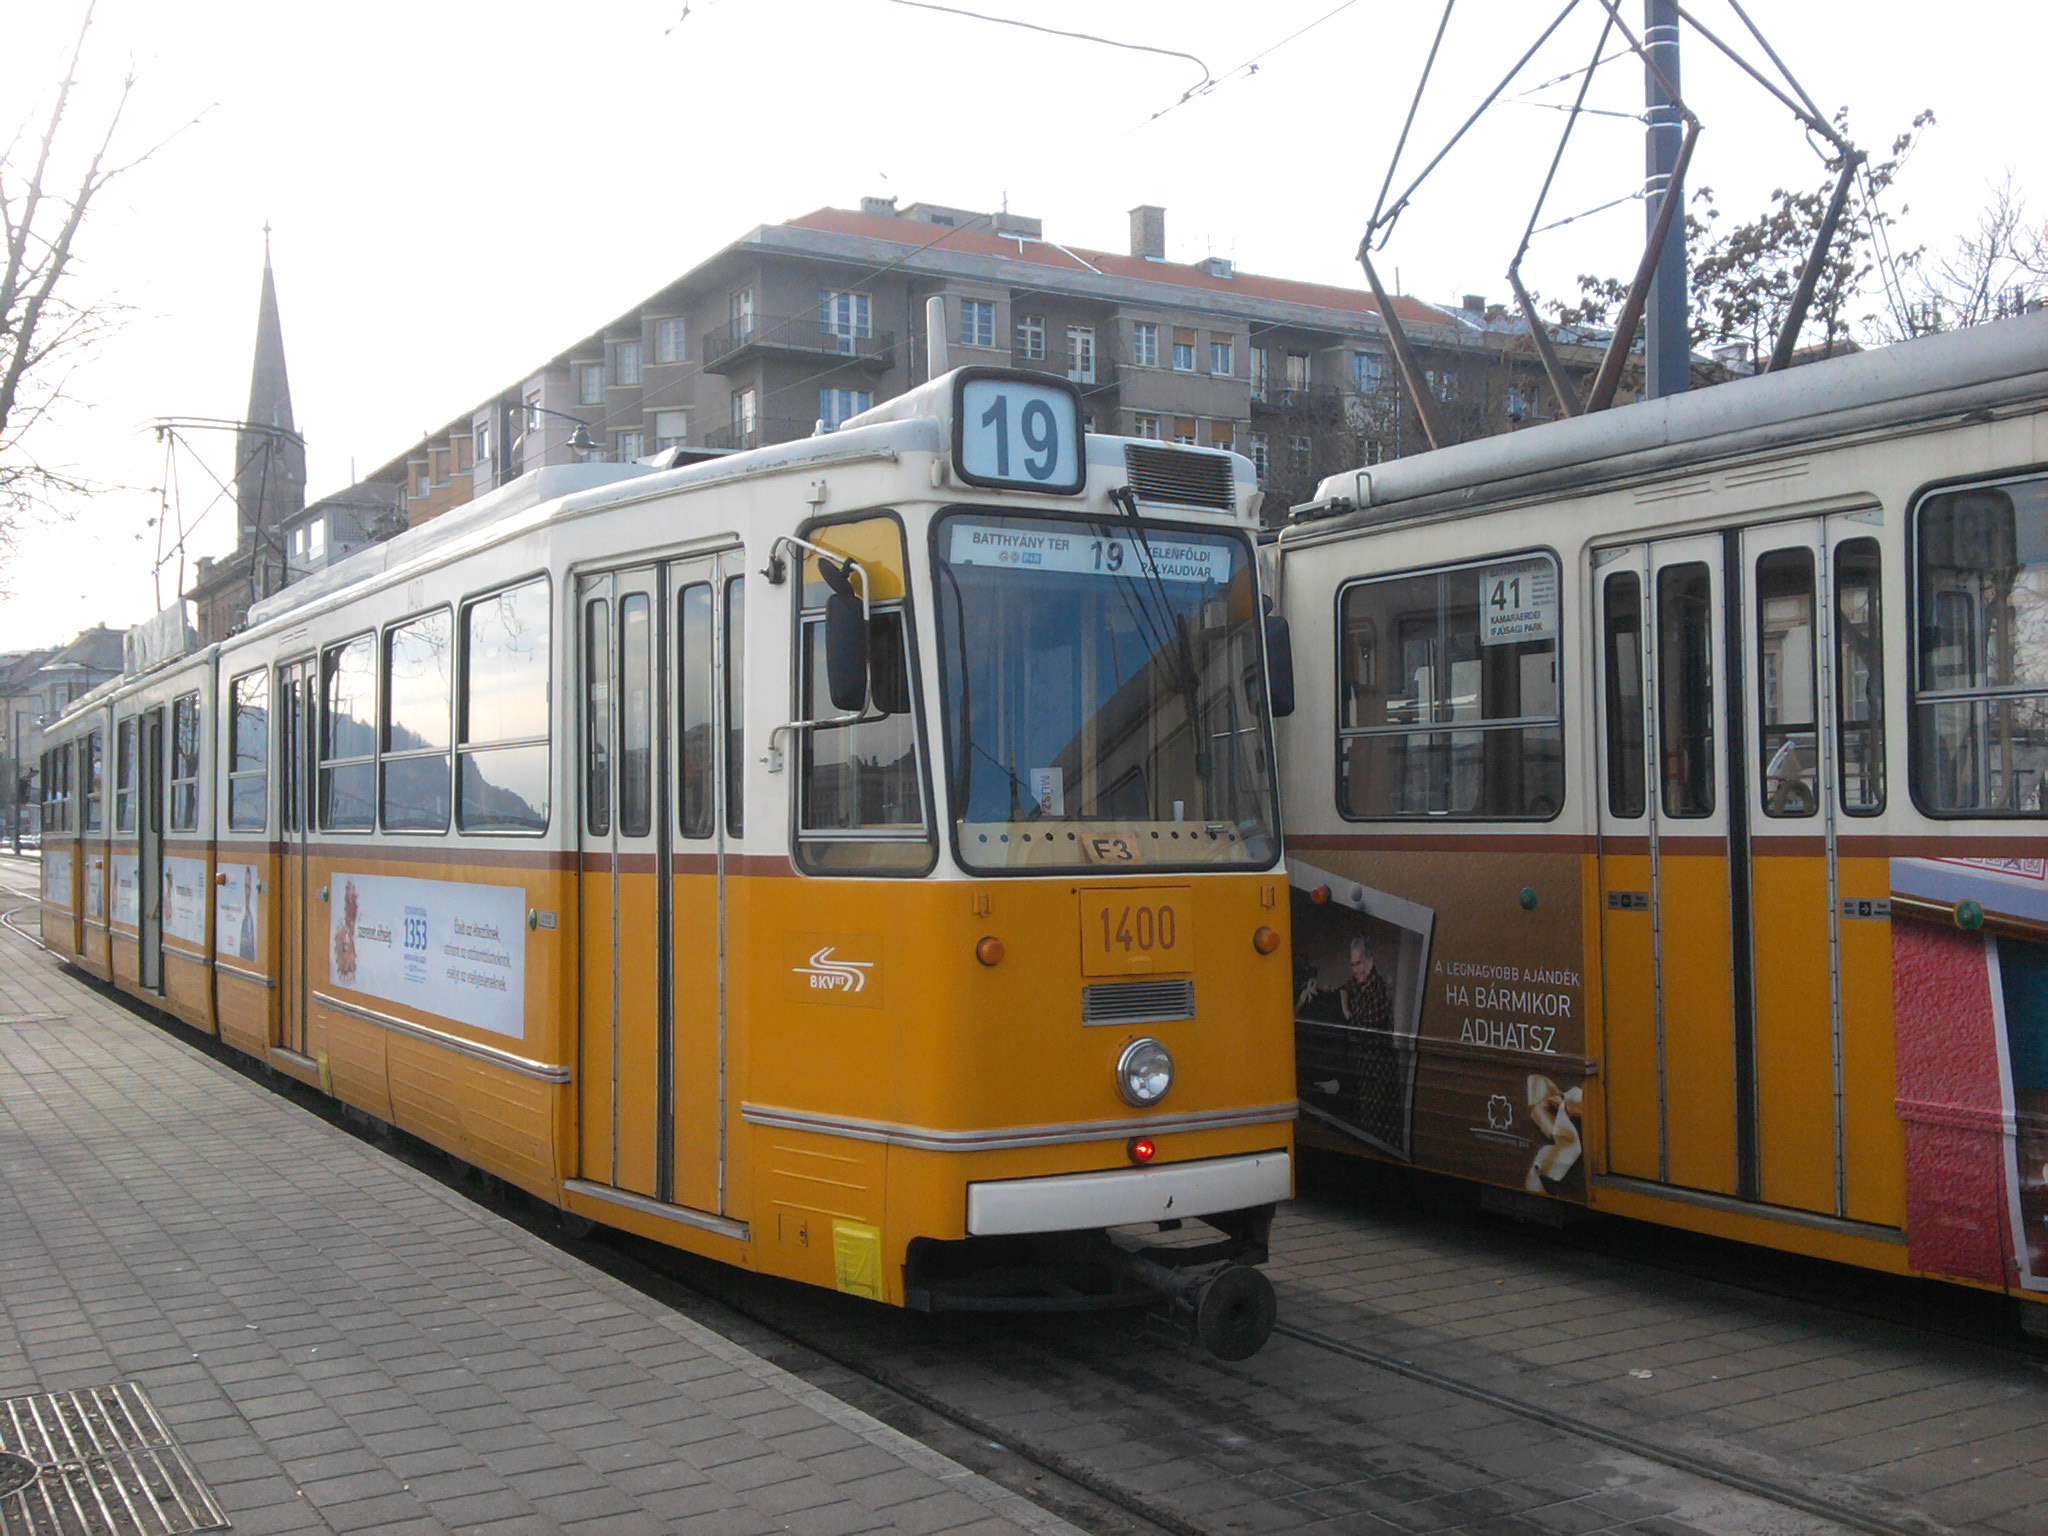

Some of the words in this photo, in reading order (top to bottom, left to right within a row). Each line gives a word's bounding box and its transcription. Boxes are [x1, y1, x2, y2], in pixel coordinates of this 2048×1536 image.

[981, 394, 1059, 482] 19
[972, 531, 1045, 551] BATTHYÁNY
[1048, 536, 1070, 552] TÉR
[1090, 540, 1124, 572] 19
[1490, 577, 1520, 611] 41
[1490, 611, 1541, 624] KAMARAERDEI
[1524, 622, 1543, 632] PARK
[1092, 839, 1133, 861] F3
[404, 917, 428, 951] 1353
[1100, 905, 1177, 952] 1400
[810, 975, 835, 989] BKV
[1434, 960, 1443, 974] A
[1446, 962, 1520, 982] LEGNAGYOBB
[1446, 984, 1470, 1007] HA
[1475, 982, 1572, 1018] BÁRMIKOR
[1460, 1018, 1558, 1054] ADHATSZ
